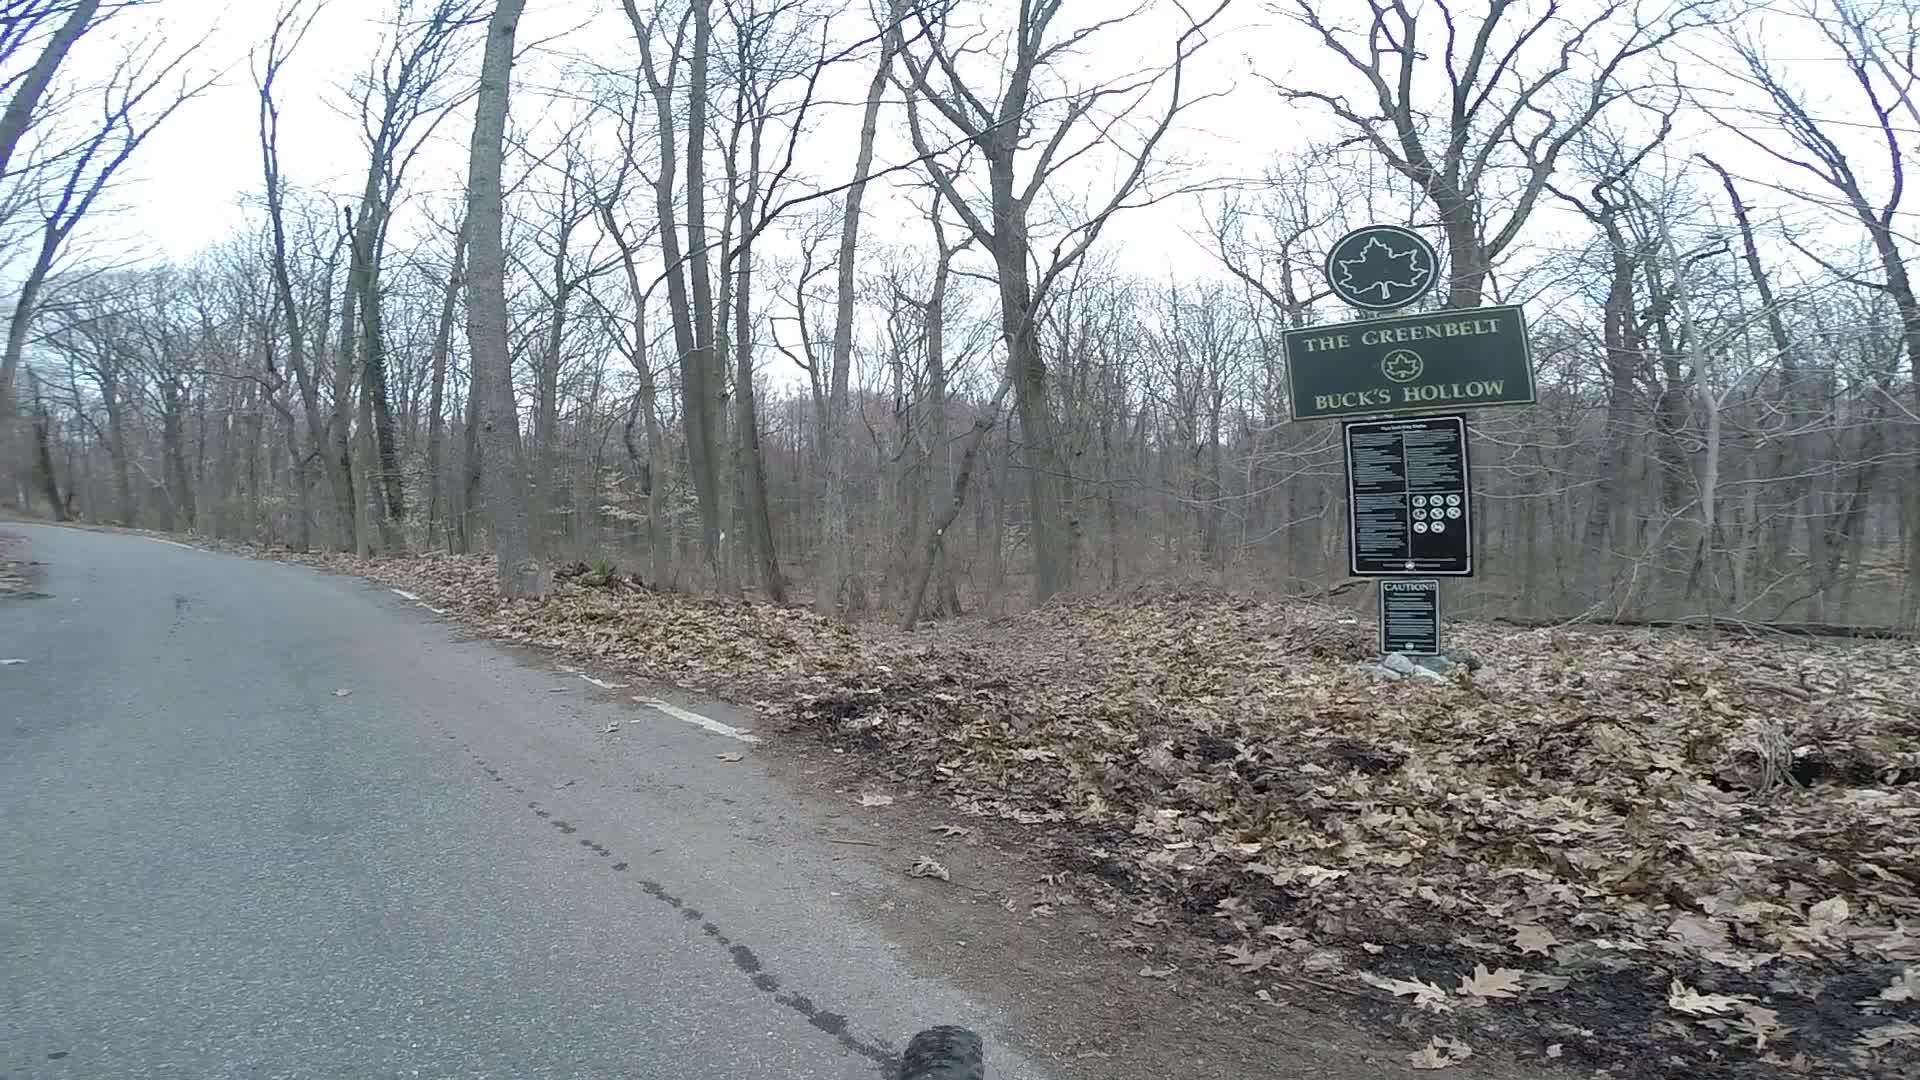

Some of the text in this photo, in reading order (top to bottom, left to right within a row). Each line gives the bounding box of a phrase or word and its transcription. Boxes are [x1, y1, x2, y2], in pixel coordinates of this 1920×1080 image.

[1304, 319, 1500, 352] THE GREENBELT
[1314, 380, 1504, 410] BUCK'S HOLLOW
